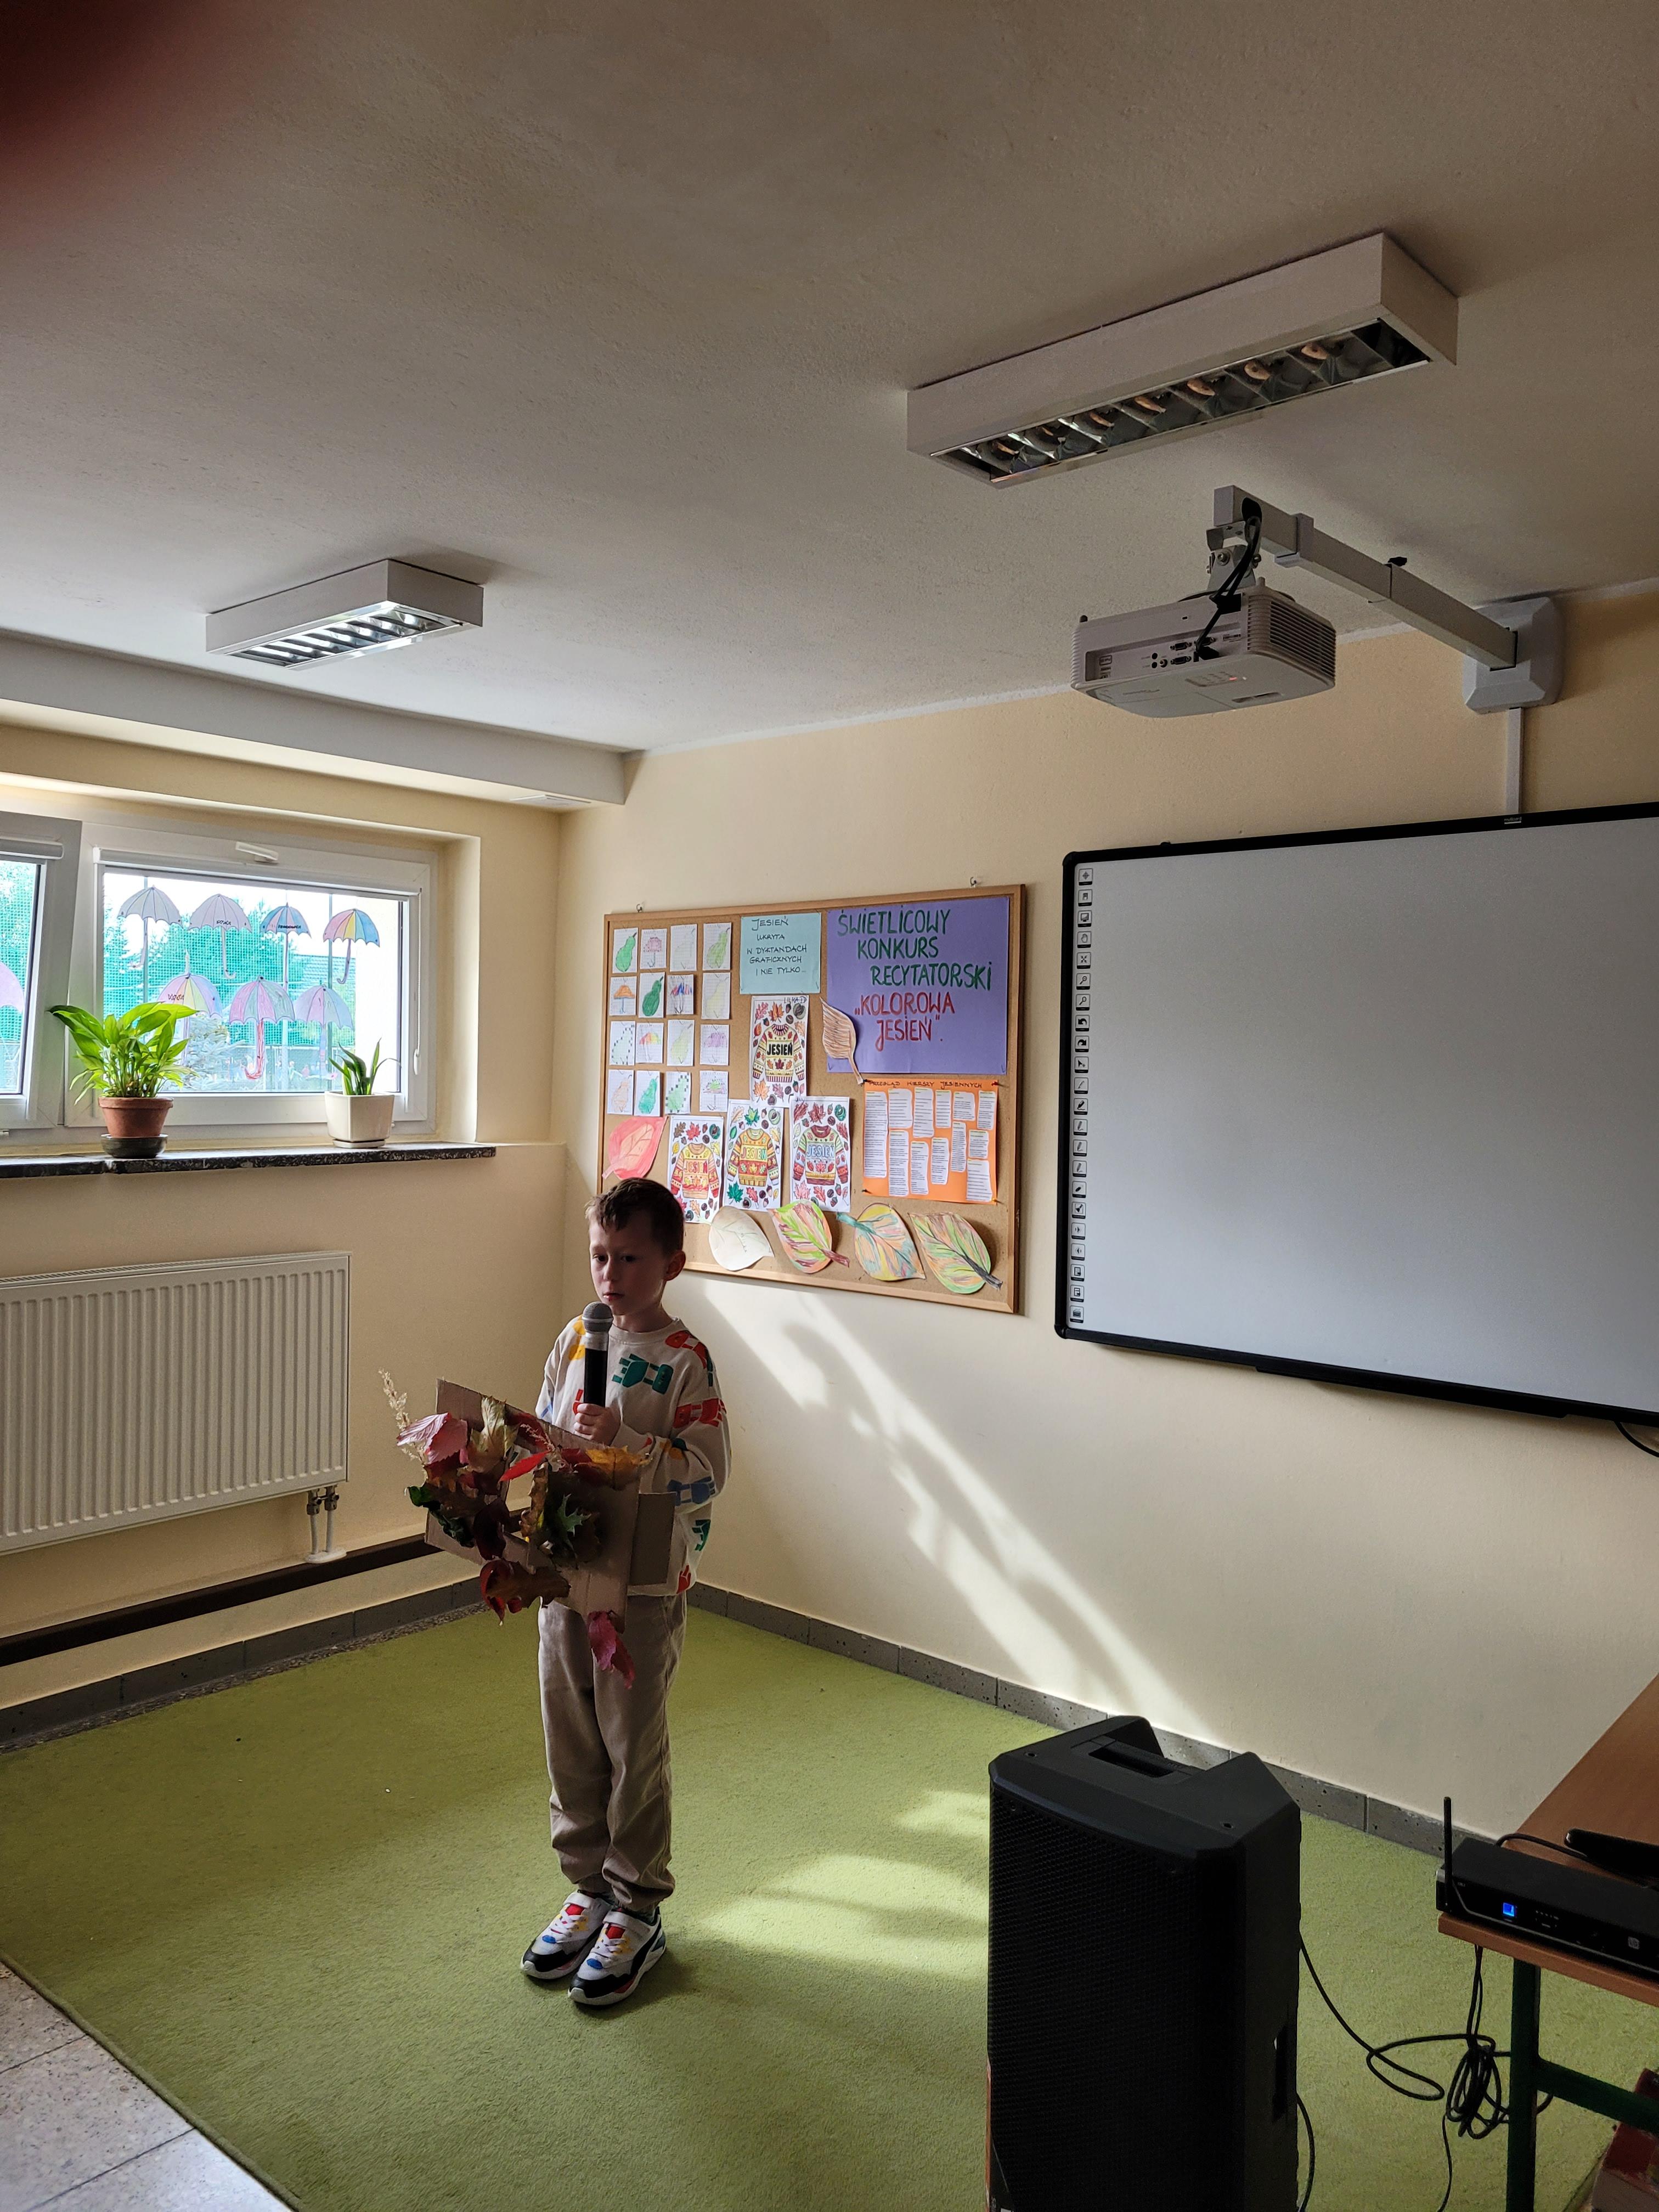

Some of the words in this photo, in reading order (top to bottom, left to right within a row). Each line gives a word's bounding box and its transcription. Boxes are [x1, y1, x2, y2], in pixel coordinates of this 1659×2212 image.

[752, 916, 788, 931] JESIEŃ
[755, 944, 807, 955] DYKTANDACH
[857, 936, 939, 960] KONKURS
[870, 962, 992, 991] RECYTATORSKI
[766, 1042, 793, 1056] JESIEŃ
[940, 1081, 983, 1090] JESIENNYCH
